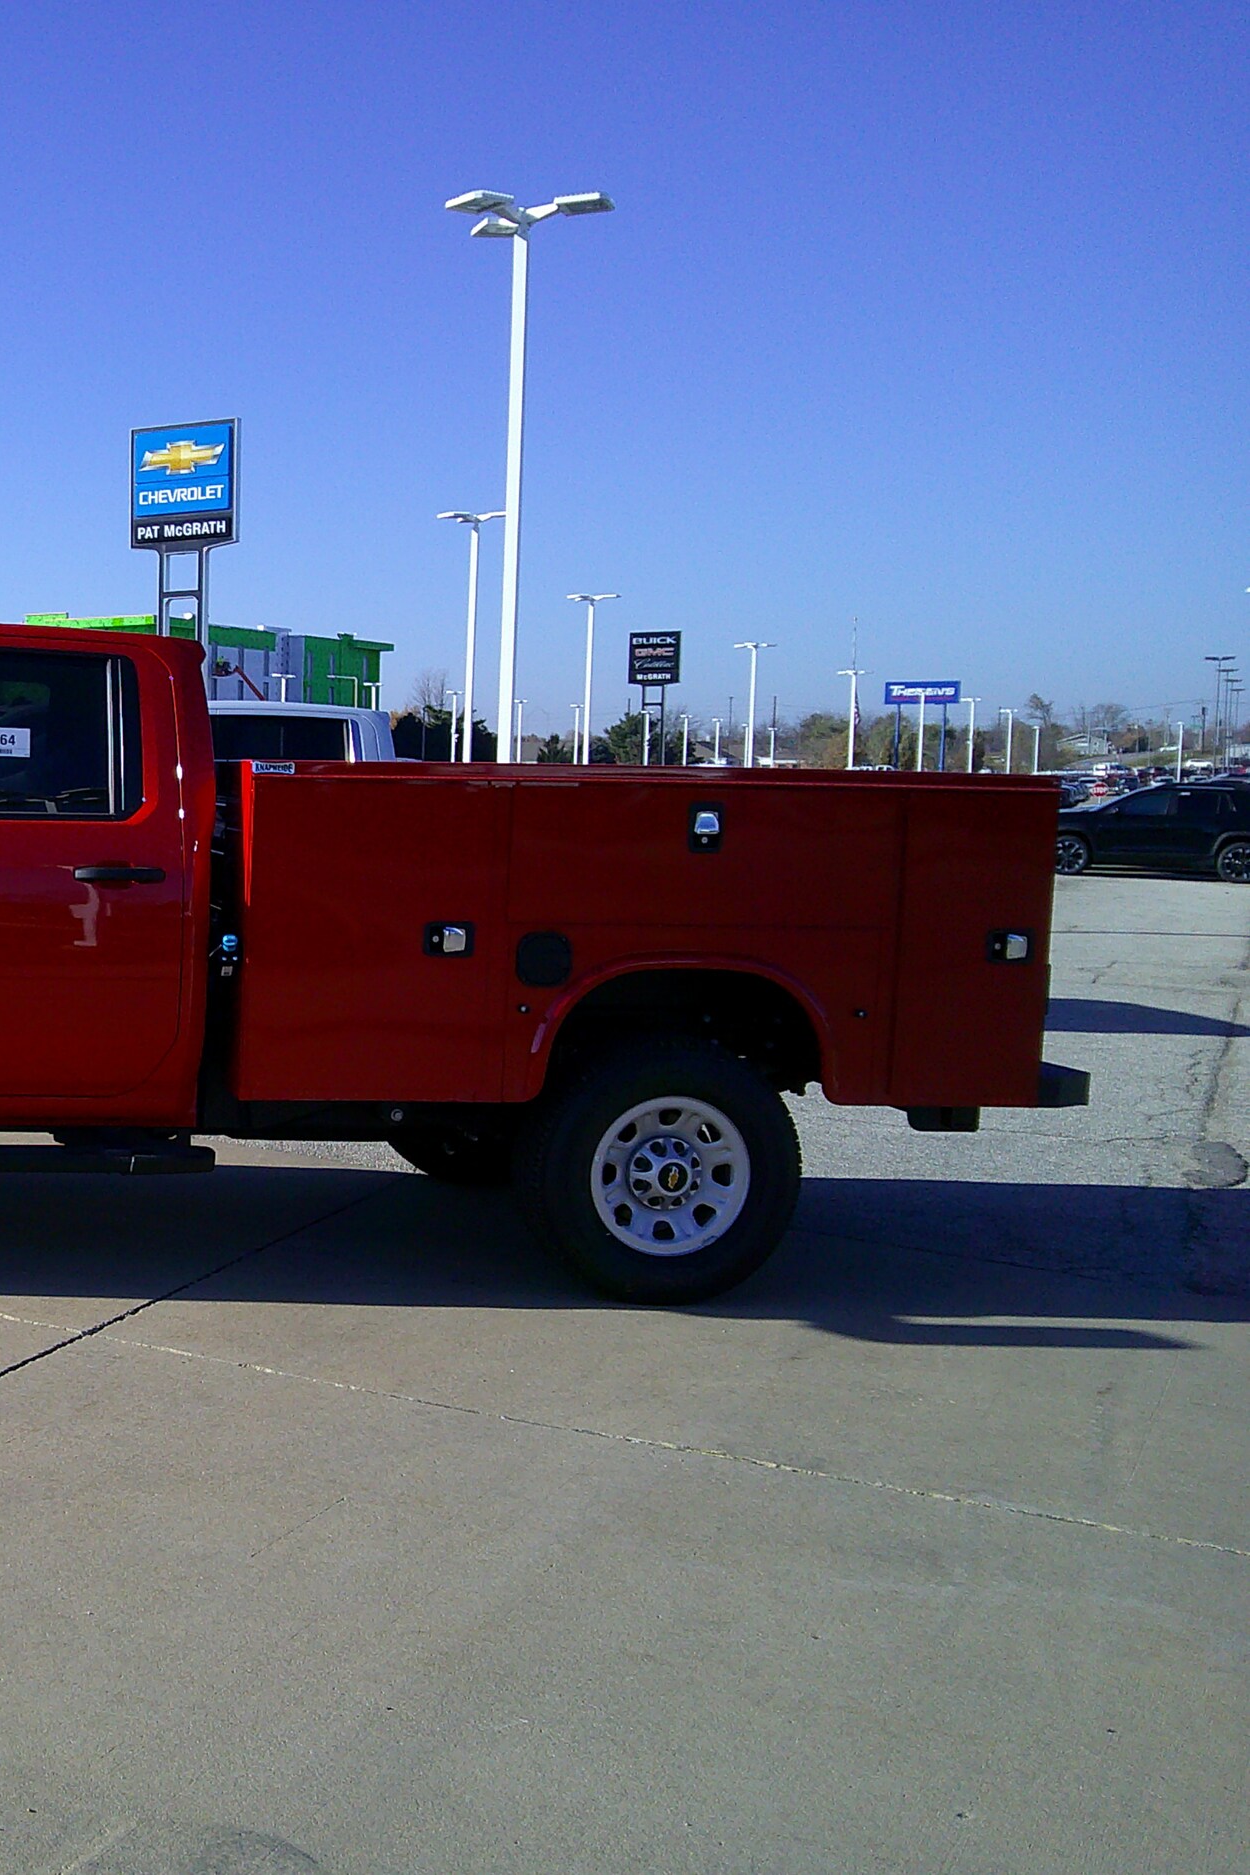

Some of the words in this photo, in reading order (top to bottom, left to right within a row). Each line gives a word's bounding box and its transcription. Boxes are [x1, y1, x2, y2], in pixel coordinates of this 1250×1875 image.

[138, 485, 225, 505] CHEVROLET
[137, 525, 160, 540] PAT
[164, 520, 226, 537] McGRATH
[632, 636, 677, 645] BUICK
[635, 647, 675, 657] GMC
